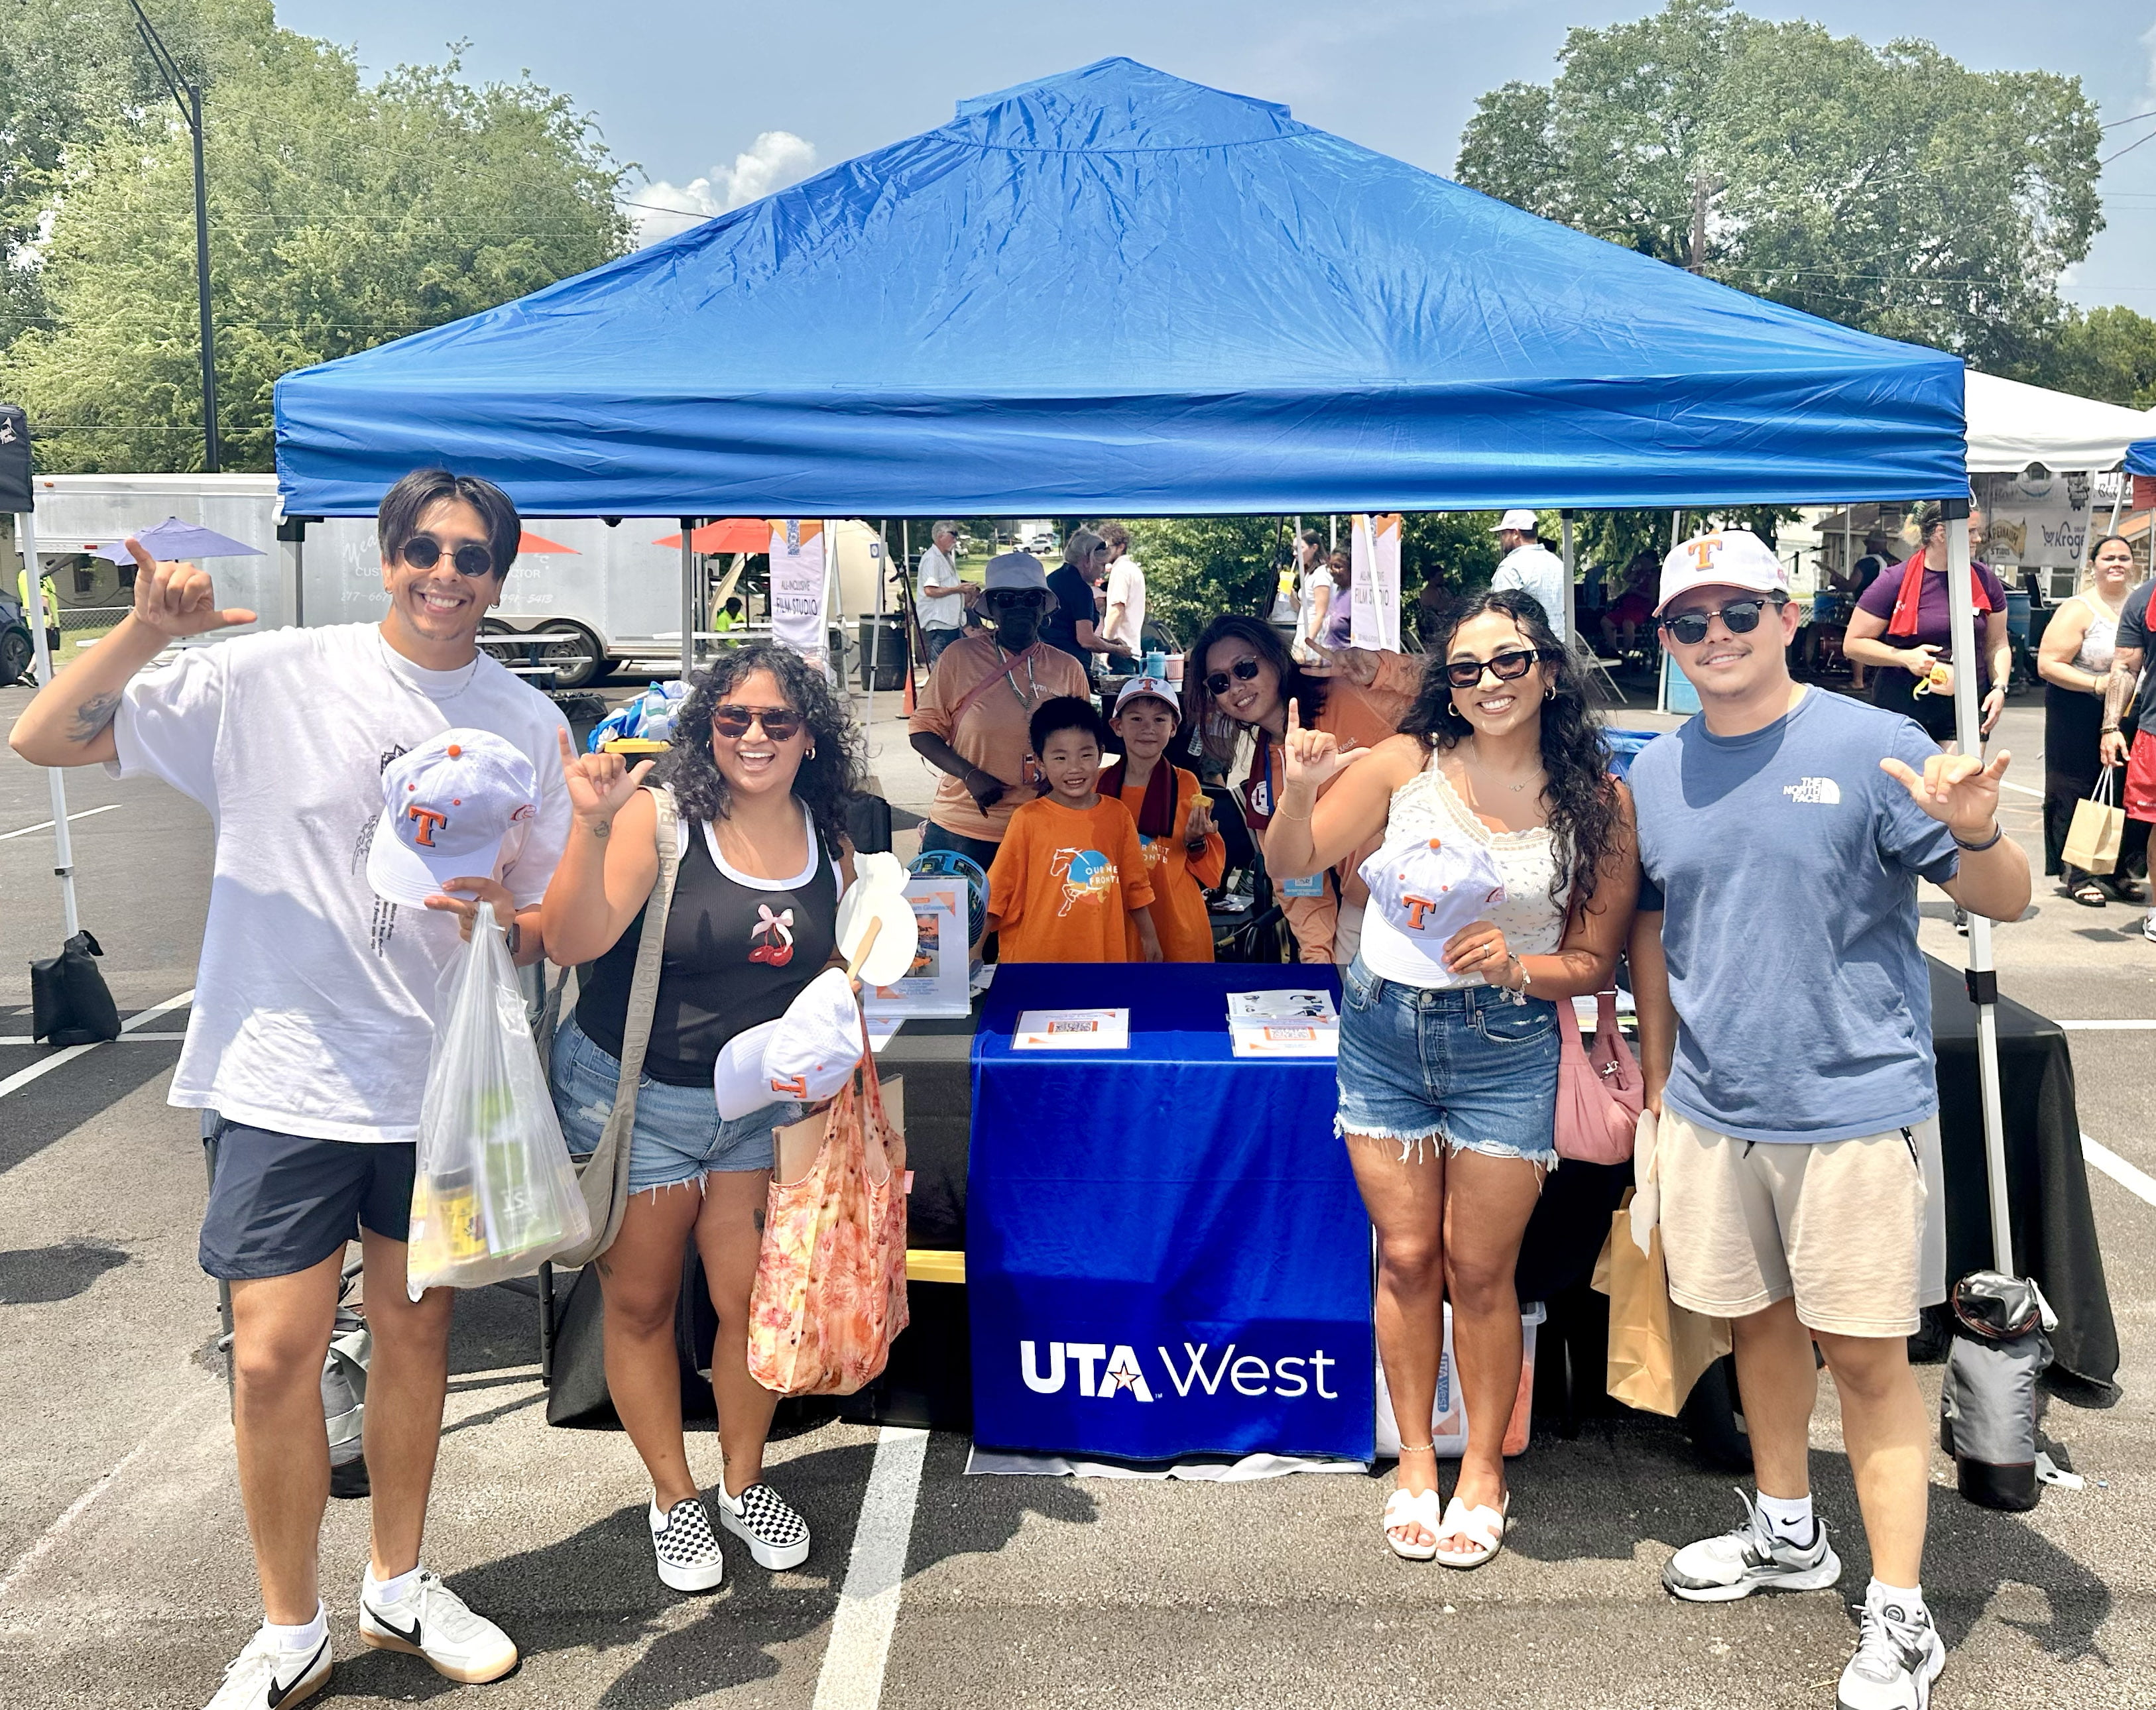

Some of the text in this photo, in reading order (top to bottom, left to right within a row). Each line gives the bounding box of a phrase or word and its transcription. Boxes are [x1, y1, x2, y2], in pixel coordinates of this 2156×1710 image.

[1688, 539, 1722, 571] T
[782, 581, 810, 591] ALL-INCLUSIVE
[1354, 588, 1367, 604] FILM
[776, 597, 817, 616] FILM STUDIO
[1138, 679, 1158, 691] T
[1783, 785, 1821, 795] NORTH
[1801, 777, 1822, 786] THE
[1793, 794, 1820, 803] FACE
[408, 805, 448, 848] T
[1106, 865, 1118, 874] NE
[1089, 875, 1119, 885] FRONTI
[1402, 895, 1436, 930] T
[631, 937, 660, 1017] BAGGU
[771, 1074, 807, 1099] T
[1020, 1340, 1154, 1402] UTA
[1158, 1343, 1338, 1399] West
[1438, 1379, 1448, 1409] West
